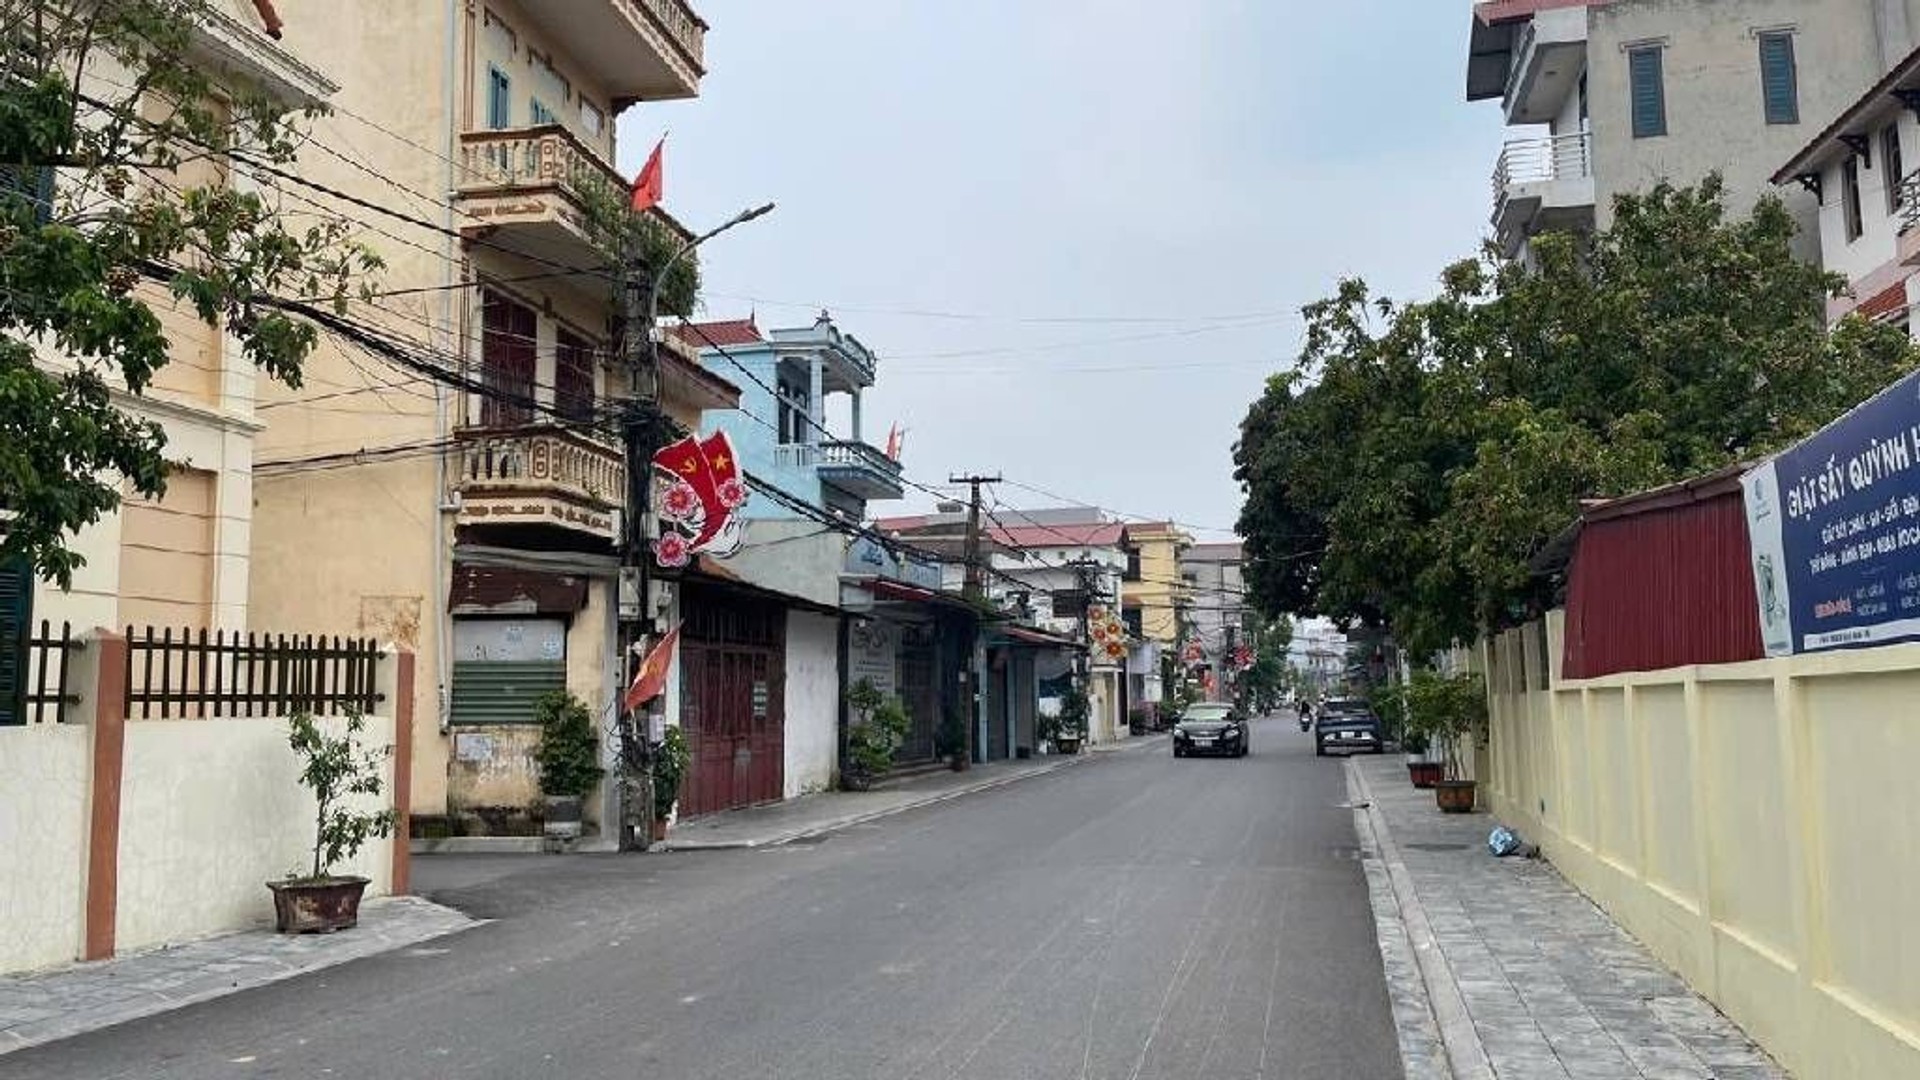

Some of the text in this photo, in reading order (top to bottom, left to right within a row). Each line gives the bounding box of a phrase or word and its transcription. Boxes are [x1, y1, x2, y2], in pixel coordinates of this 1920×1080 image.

[1787, 476, 1816, 521] GIẶT
[1819, 453, 1845, 505] SẤY
[1849, 431, 1909, 490] QUỲNH
